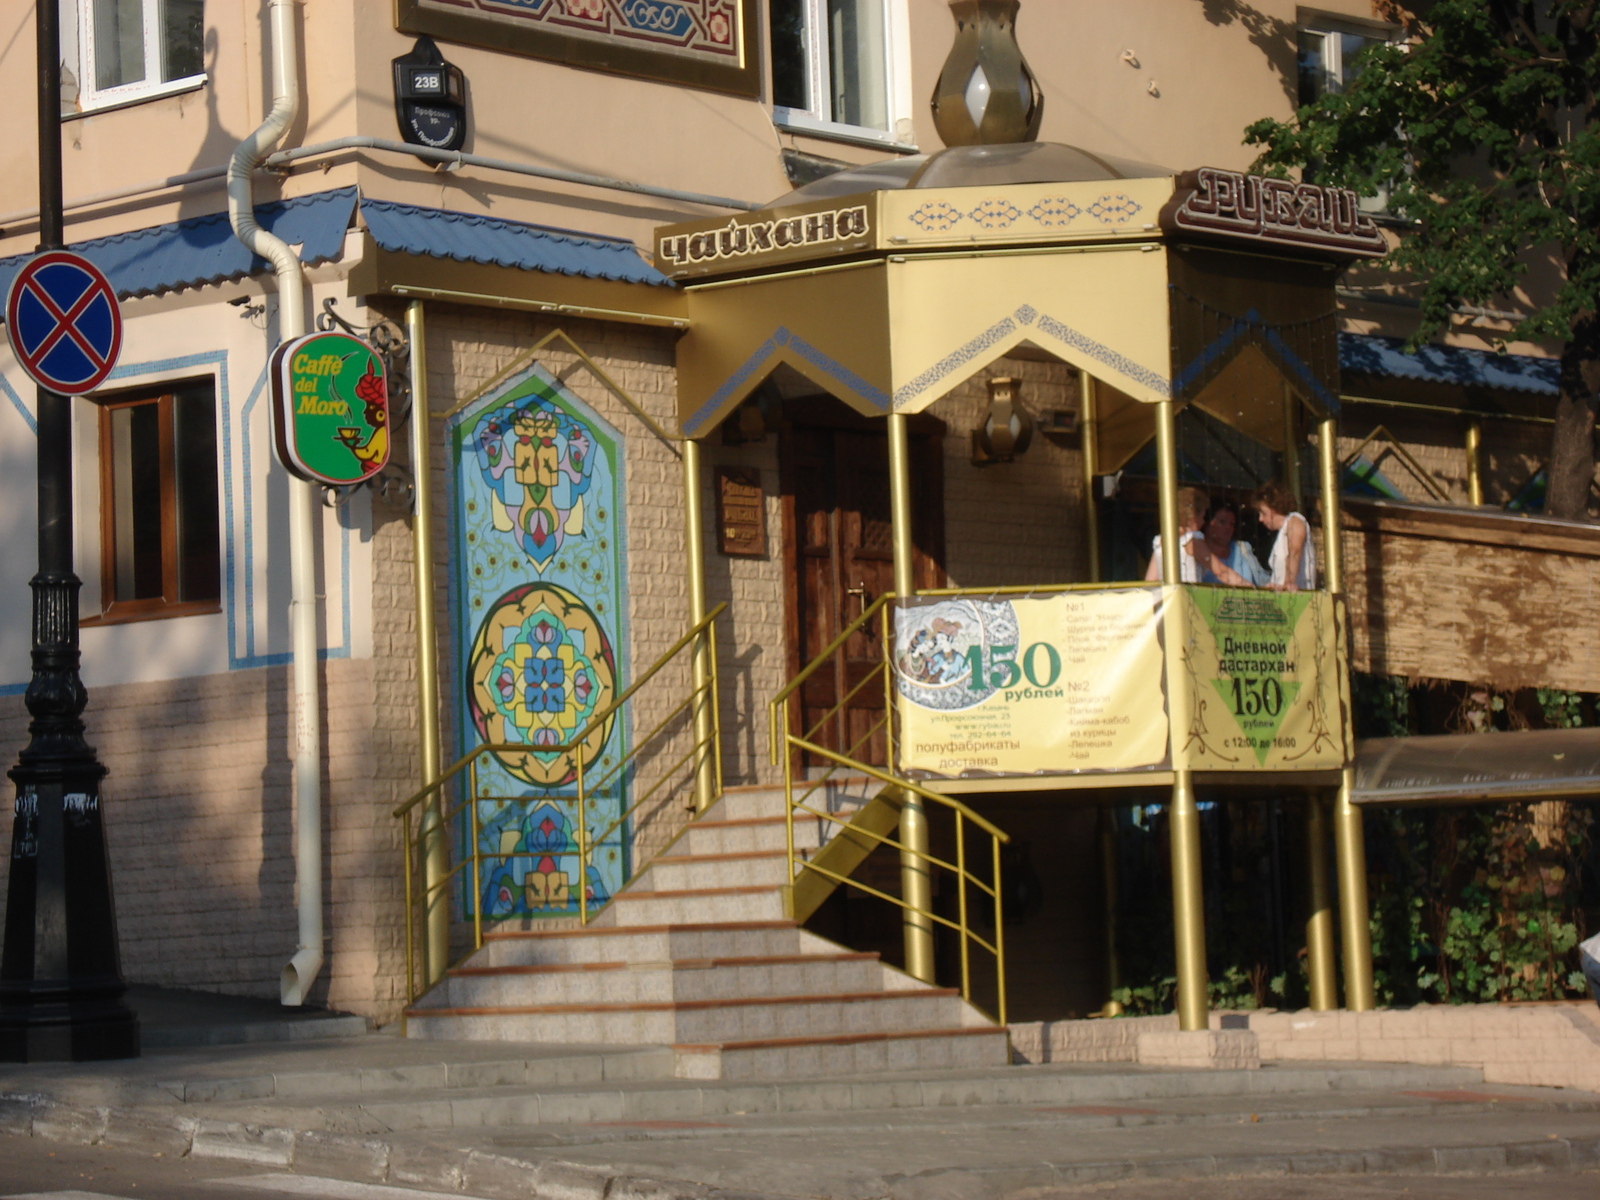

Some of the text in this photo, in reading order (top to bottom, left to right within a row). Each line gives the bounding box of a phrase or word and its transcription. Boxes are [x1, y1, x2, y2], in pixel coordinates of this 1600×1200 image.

[293, 353, 343, 376] Caffè
[294, 377, 319, 393] del
[297, 395, 348, 416] Moro
[1224, 637, 1287, 656] Дневной
[962, 642, 1062, 691] 150
[1219, 659, 1296, 676] дастархан
[1005, 686, 1064, 702] рублей
[1068, 681, 1090, 692] №2
[1231, 677, 1283, 717] 150
[1083, 729, 1117, 738] курицы
[916, 740, 1021, 754] полуфабрикаты
[1232, 738, 1257, 748] 12:00
[1273, 738, 1296, 748] 16:00
[939, 757, 999, 769] доставка
